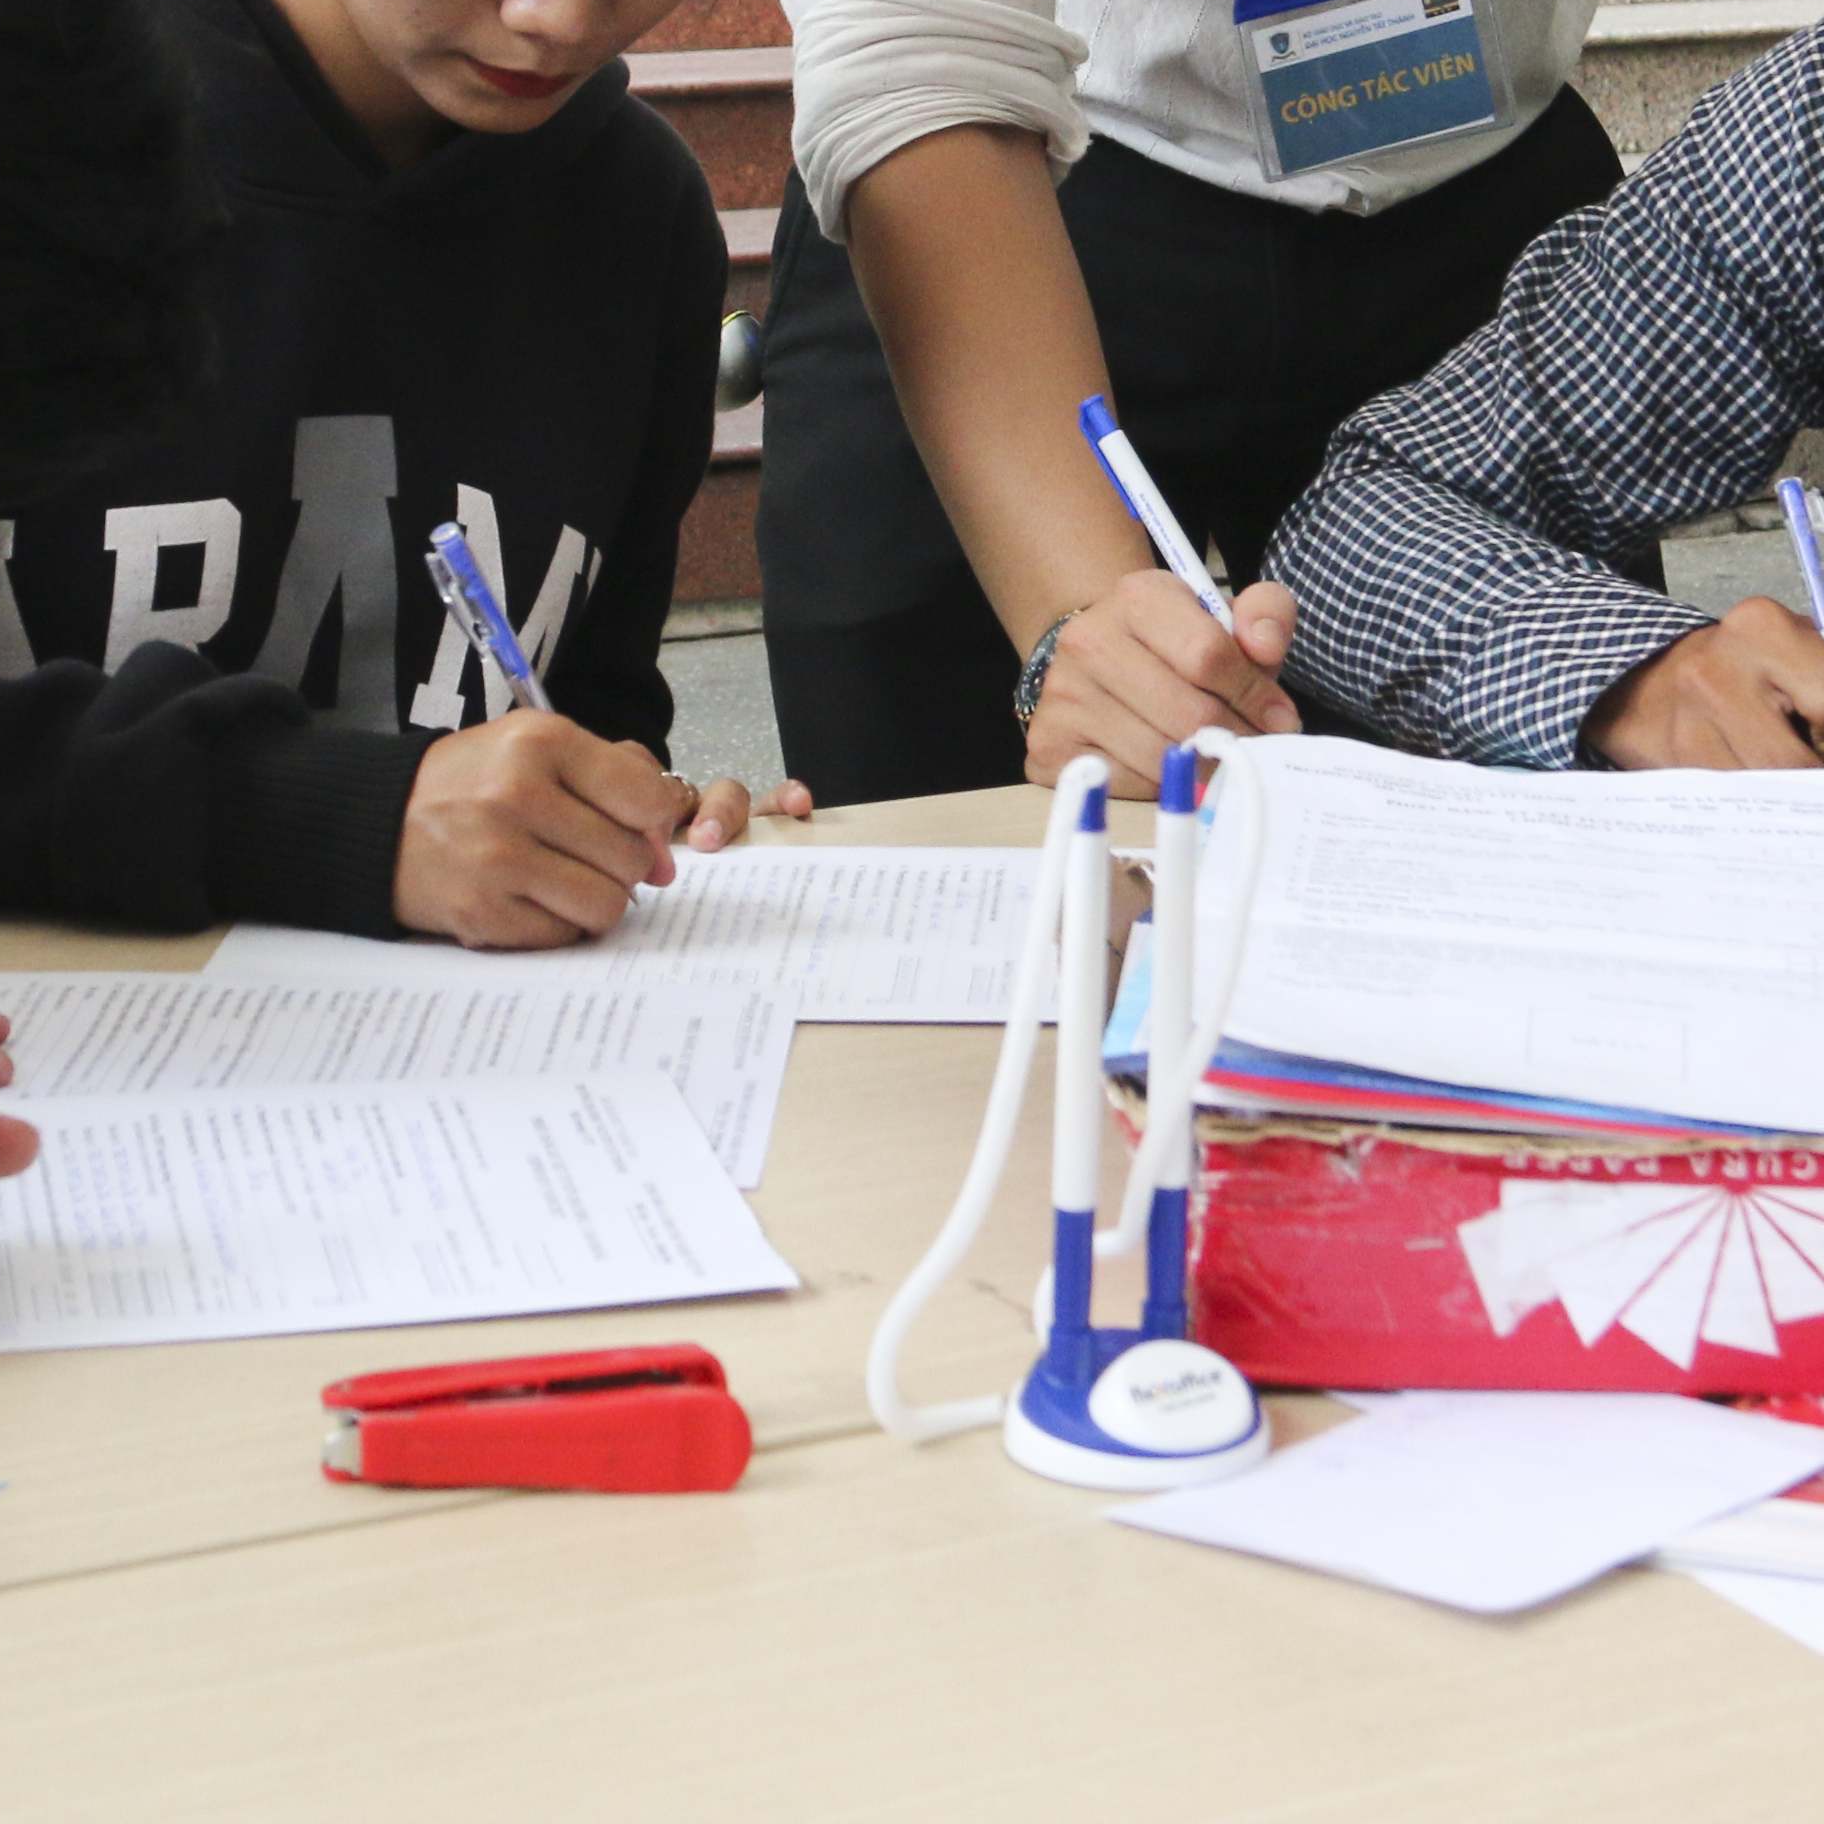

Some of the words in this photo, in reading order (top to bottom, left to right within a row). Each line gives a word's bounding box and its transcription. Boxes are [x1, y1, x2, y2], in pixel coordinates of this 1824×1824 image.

[1280, 85, 1358, 124] CỘNG
[1360, 70, 1411, 101] TÁC
[1413, 52, 1476, 87] VIÊN
